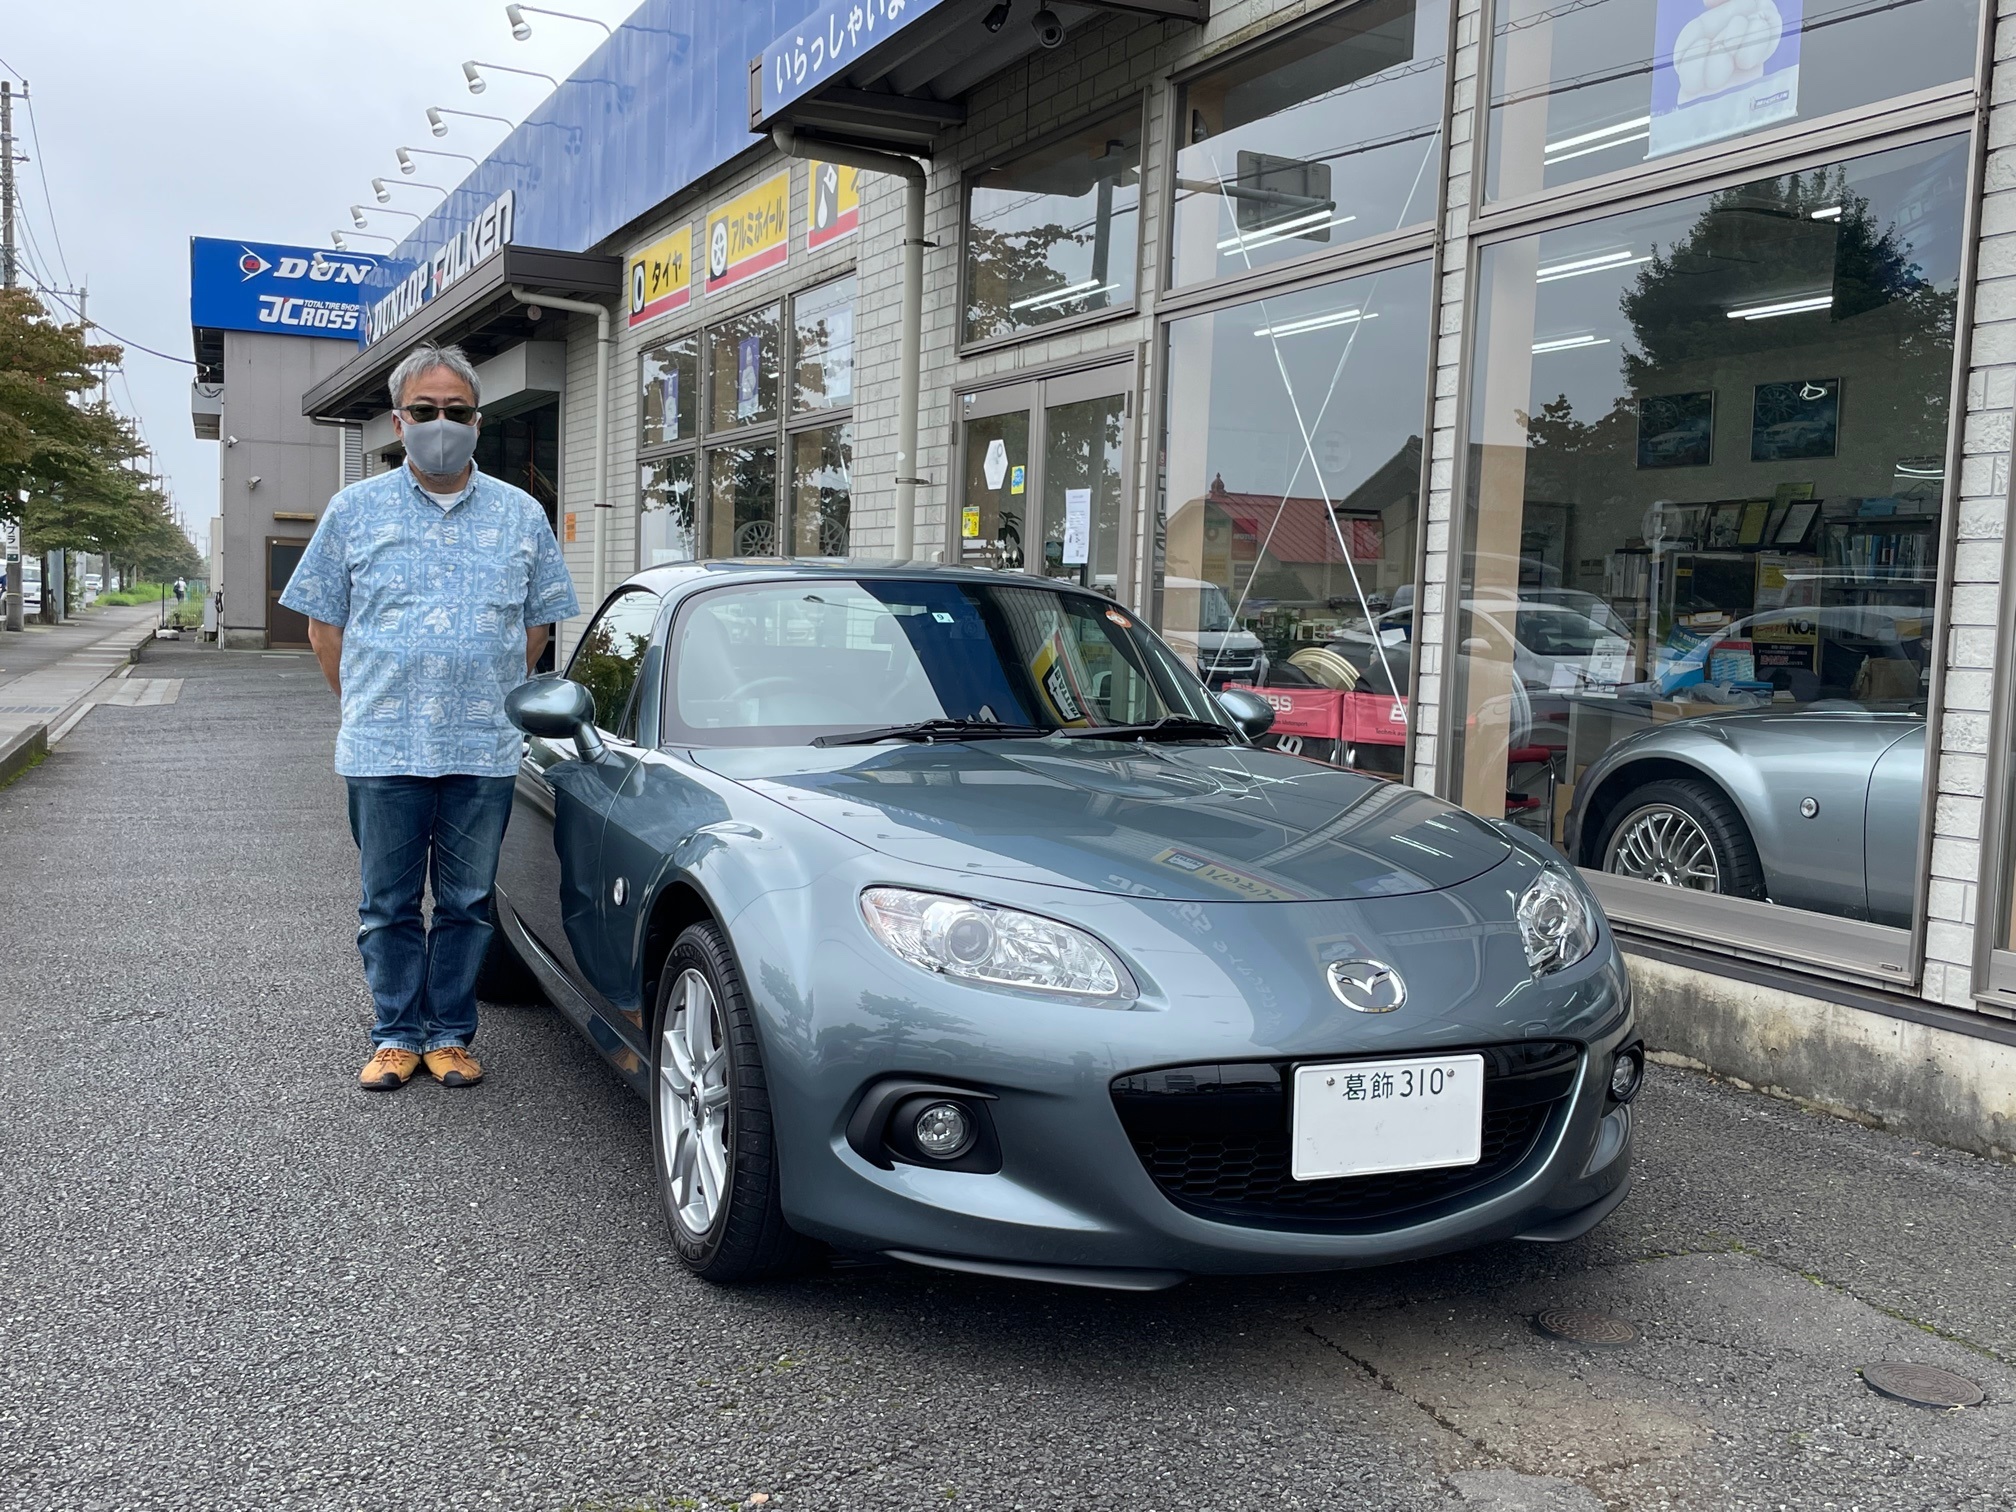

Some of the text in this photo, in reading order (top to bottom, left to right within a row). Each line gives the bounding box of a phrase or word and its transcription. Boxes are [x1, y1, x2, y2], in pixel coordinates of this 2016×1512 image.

[731, 196, 785, 257] アルミホイール
[652, 249, 683, 294] タイヤ
[303, 300, 360, 312] TOTAL TIRE SHOP
[372, 261, 429, 343] DUNLOP
[1262, 694, 1293, 712] BS
